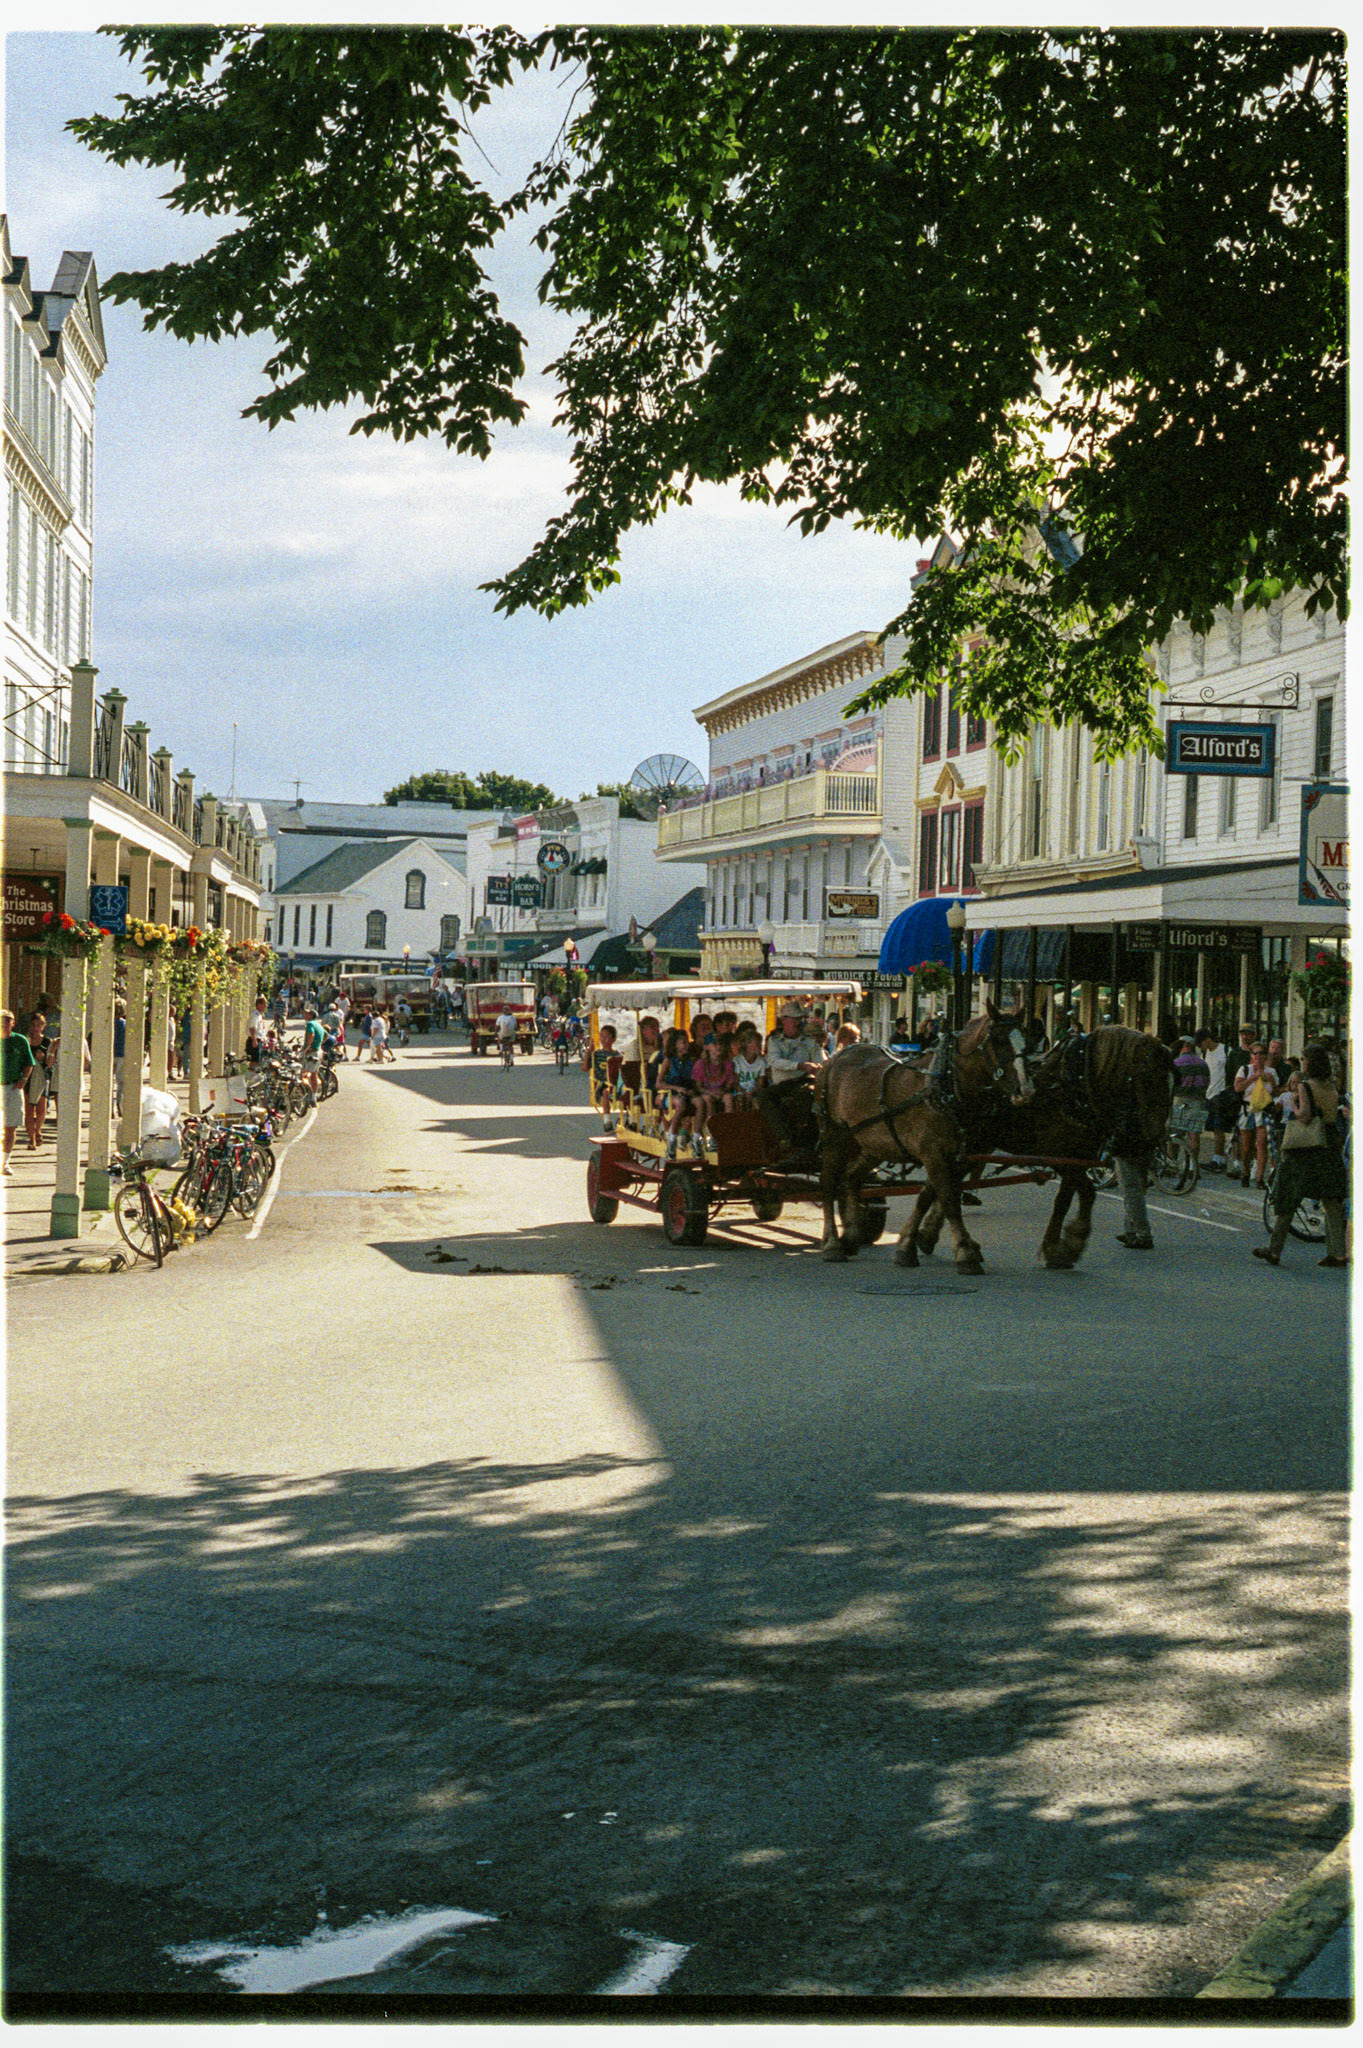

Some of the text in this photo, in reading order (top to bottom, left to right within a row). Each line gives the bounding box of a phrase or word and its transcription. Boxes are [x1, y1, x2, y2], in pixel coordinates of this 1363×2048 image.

[1181, 737, 1261, 758] Alford's
[7, 885, 26, 896] The
[515, 883, 540, 891] HORN'S
[1, 896, 54, 912] hristmas
[520, 897, 534, 906] BAR
[4, 912, 36, 925] Store
